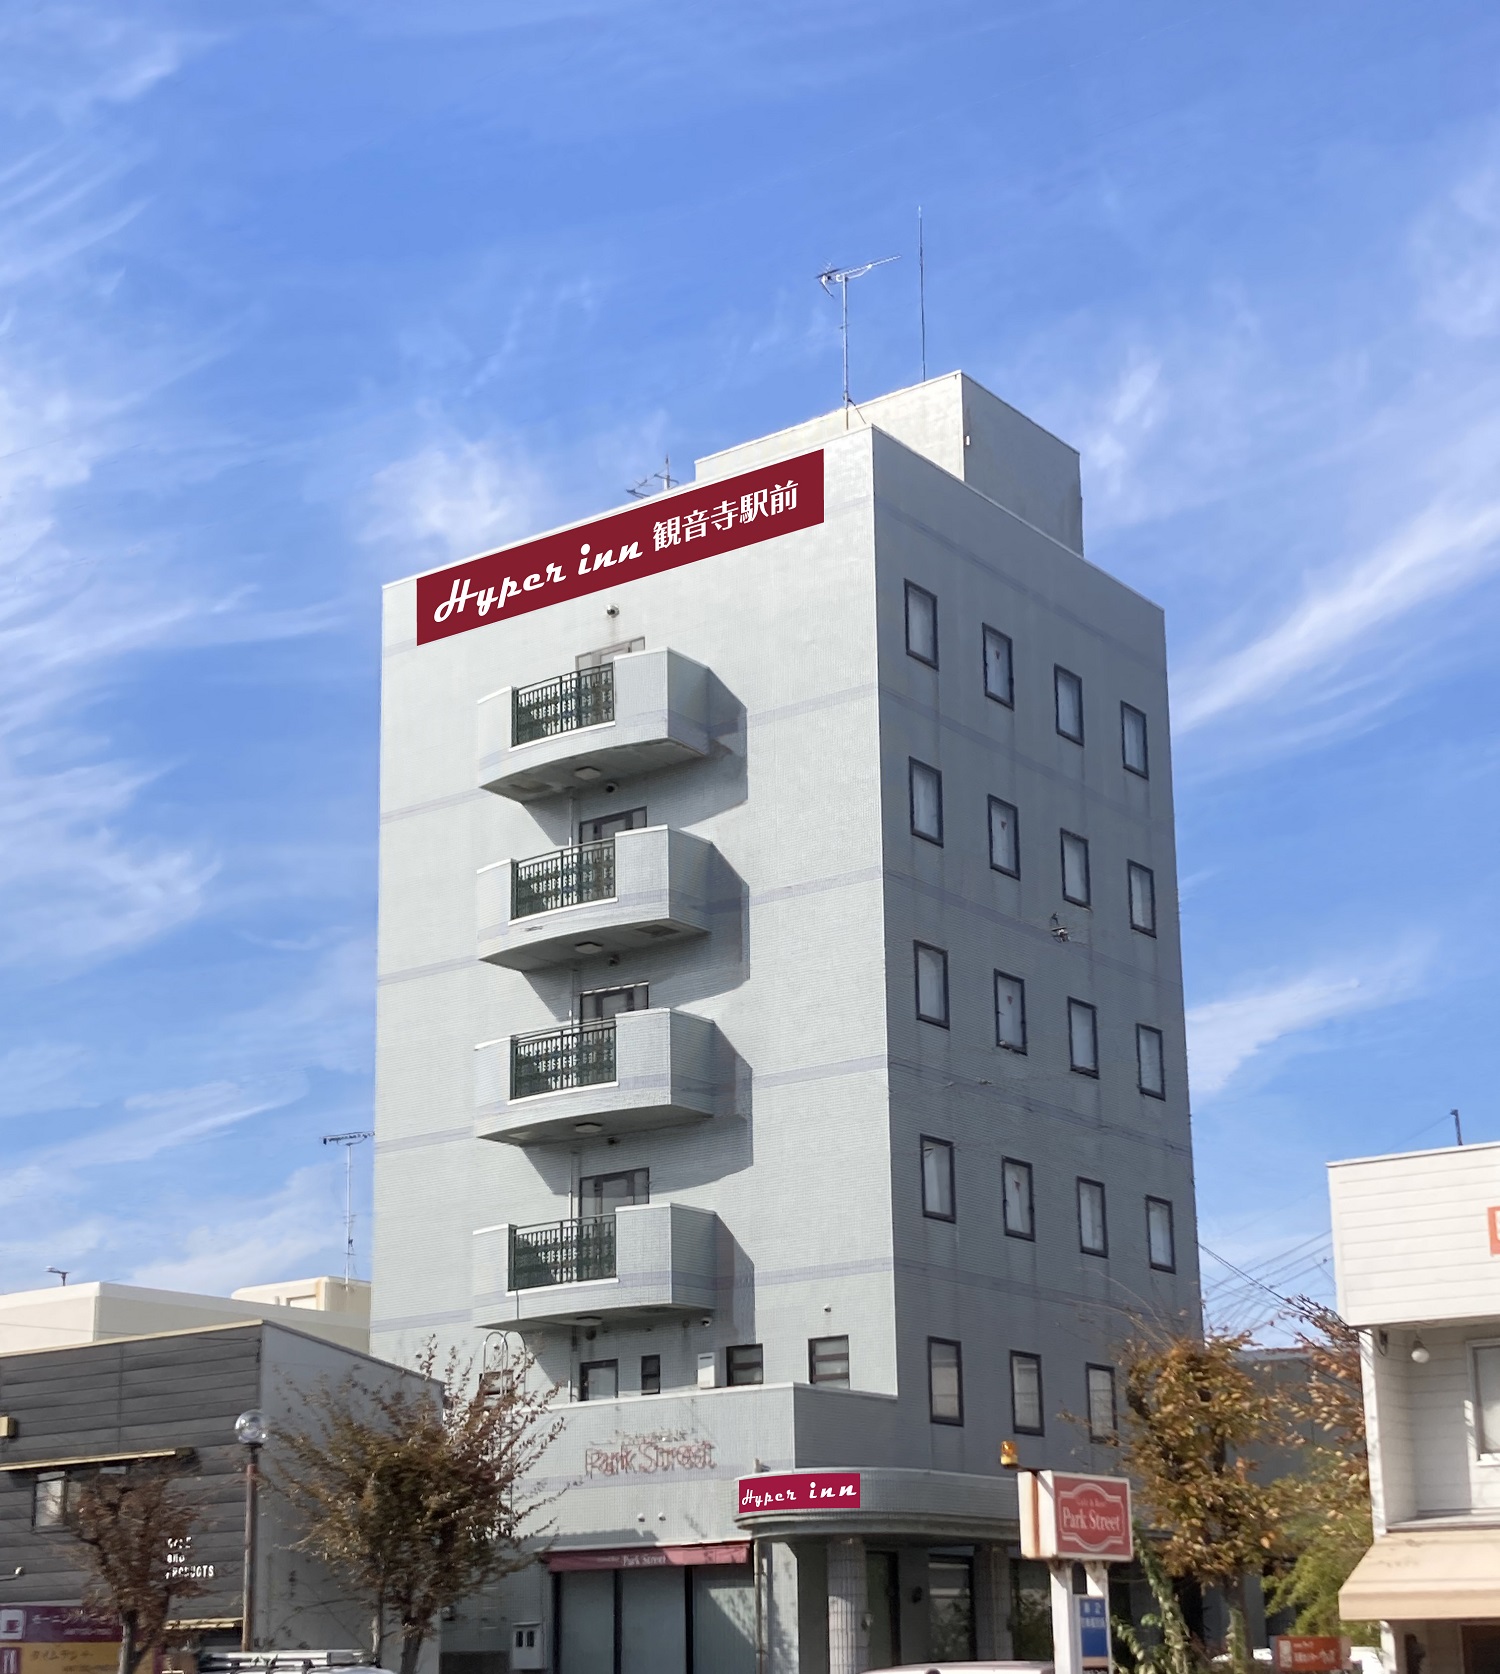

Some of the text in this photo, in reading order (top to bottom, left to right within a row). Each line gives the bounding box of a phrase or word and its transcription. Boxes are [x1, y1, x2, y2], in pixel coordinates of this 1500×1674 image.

[433, 479, 799, 623] Hyper inn 観音寺駅前
[741, 1481, 857, 1508] Hyper inn
[1063, 1506, 1120, 1532] Park Street
